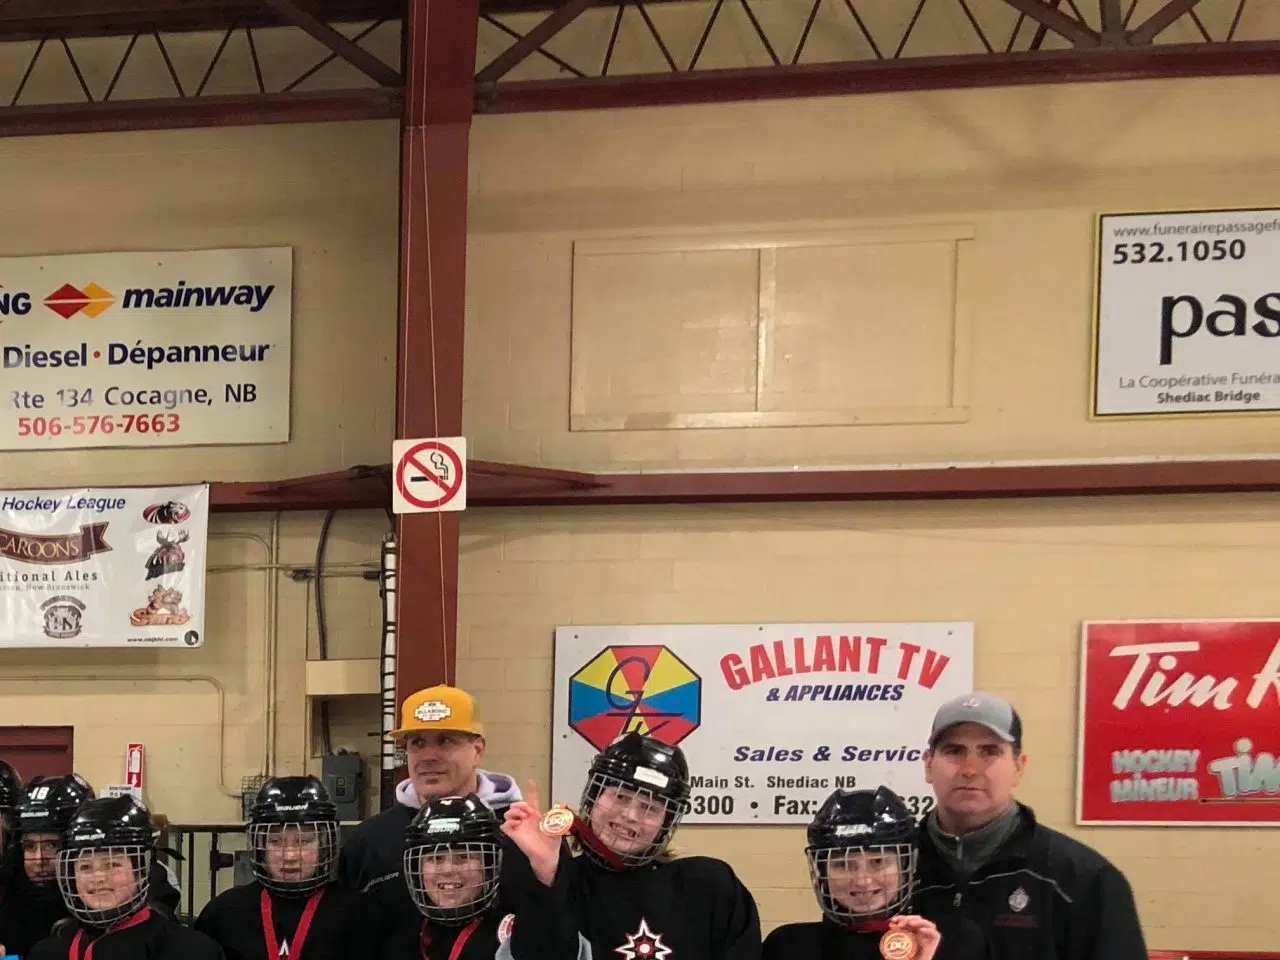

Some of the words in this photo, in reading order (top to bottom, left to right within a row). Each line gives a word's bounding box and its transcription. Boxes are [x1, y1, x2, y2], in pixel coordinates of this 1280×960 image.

[1113, 239, 1246, 264] 532.1050
[122, 281, 275, 313] mainway
[3, 343, 88, 369] Diesel
[108, 340, 271, 370] Dépanneur
[1119, 376, 1135, 389] La
[1139, 372, 1228, 389] Coopérative
[9, 389, 45, 409] Rte
[55, 388, 93, 407] 134
[104, 385, 213, 410] Cocagne,
[225, 383, 257, 403] NB
[1157, 391, 1211, 404] Shediac
[1214, 389, 1261, 404] Bridge
[18, 414, 181, 437] 506-576-7663
[2, 496, 63, 513] Hockey
[67, 495, 126, 513] League
[64, 570, 98, 582] Ales
[720, 635, 888, 691] GALLANT
[896, 641, 951, 690] TV
[1108, 640, 1239, 711] Tim
[766, 687, 780, 702] &
[783, 684, 906, 702] APPLIANCES
[733, 745, 804, 762] Sales
[813, 745, 832, 762] &
[690, 776, 729, 789] Main
[734, 776, 755, 789] St.
[766, 776, 829, 788] Shediac
[834, 776, 856, 788] NB
[773, 795, 818, 815] Fax:
[898, 795, 934, 816] 32
